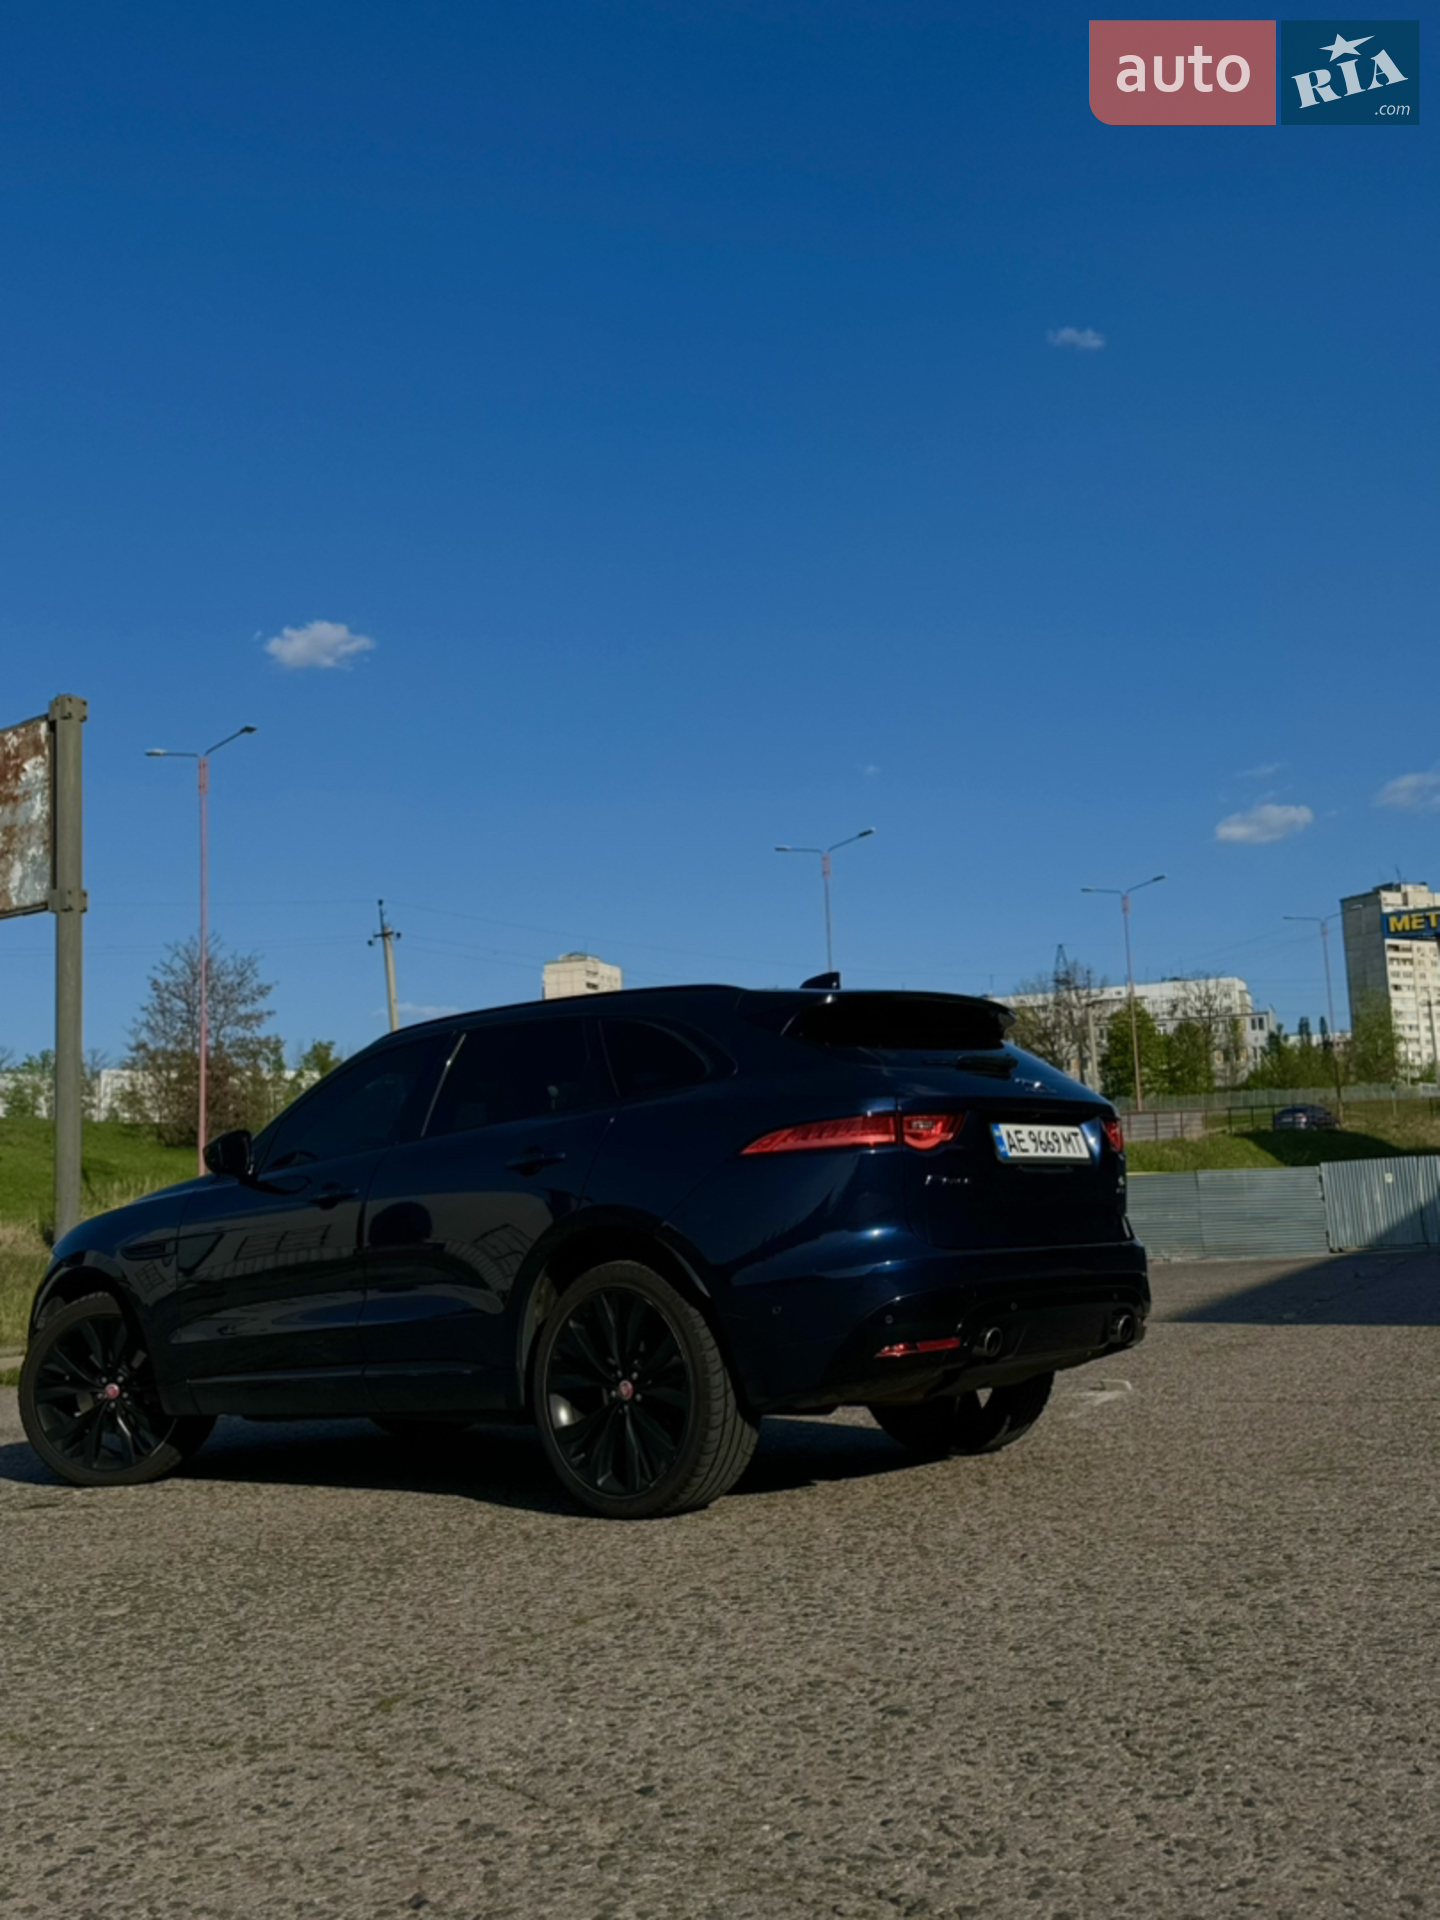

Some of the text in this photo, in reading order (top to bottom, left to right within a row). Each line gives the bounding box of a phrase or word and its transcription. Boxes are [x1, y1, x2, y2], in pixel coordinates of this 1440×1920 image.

[1006, 1130, 1083, 1154] AE 9669 MT
